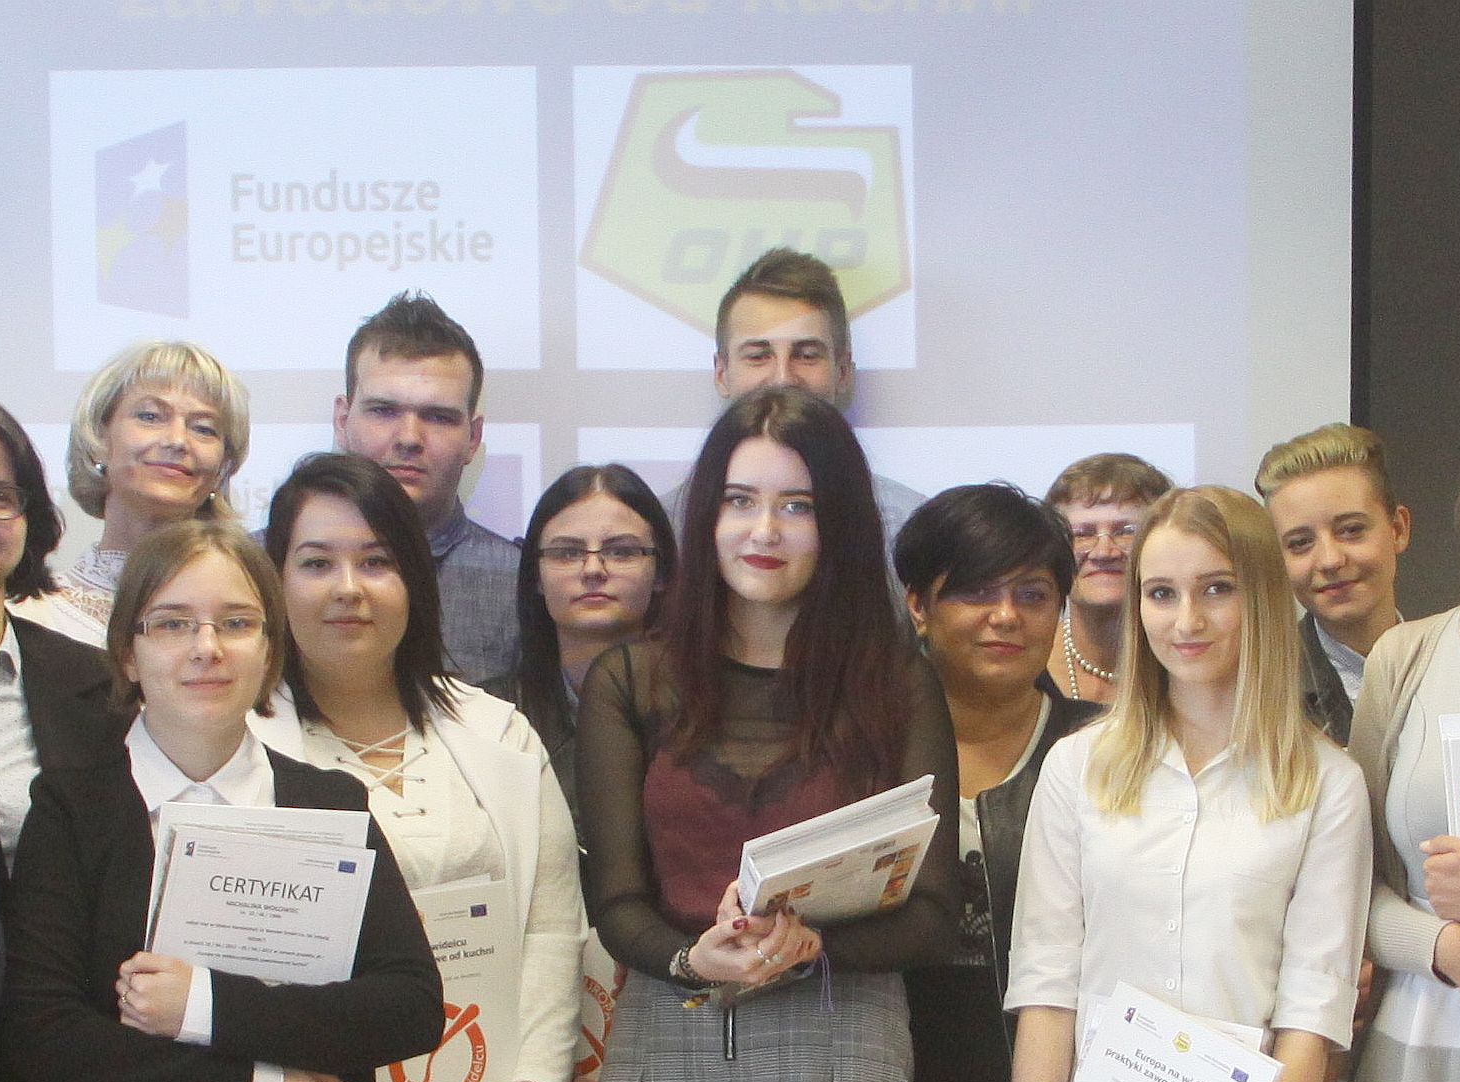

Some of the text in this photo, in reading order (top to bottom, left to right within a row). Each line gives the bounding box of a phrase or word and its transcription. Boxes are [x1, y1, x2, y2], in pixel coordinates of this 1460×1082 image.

[230, 168, 442, 213] Fundusze
[231, 219, 495, 273] Europejskie
[209, 875, 325, 903] CERTYFIKAT
[462, 944, 495, 958] kuchni
[1104, 1047, 1144, 1073] praktyki
[1134, 1048, 1167, 1072] Europa
[1168, 1068, 1180, 1080] na
